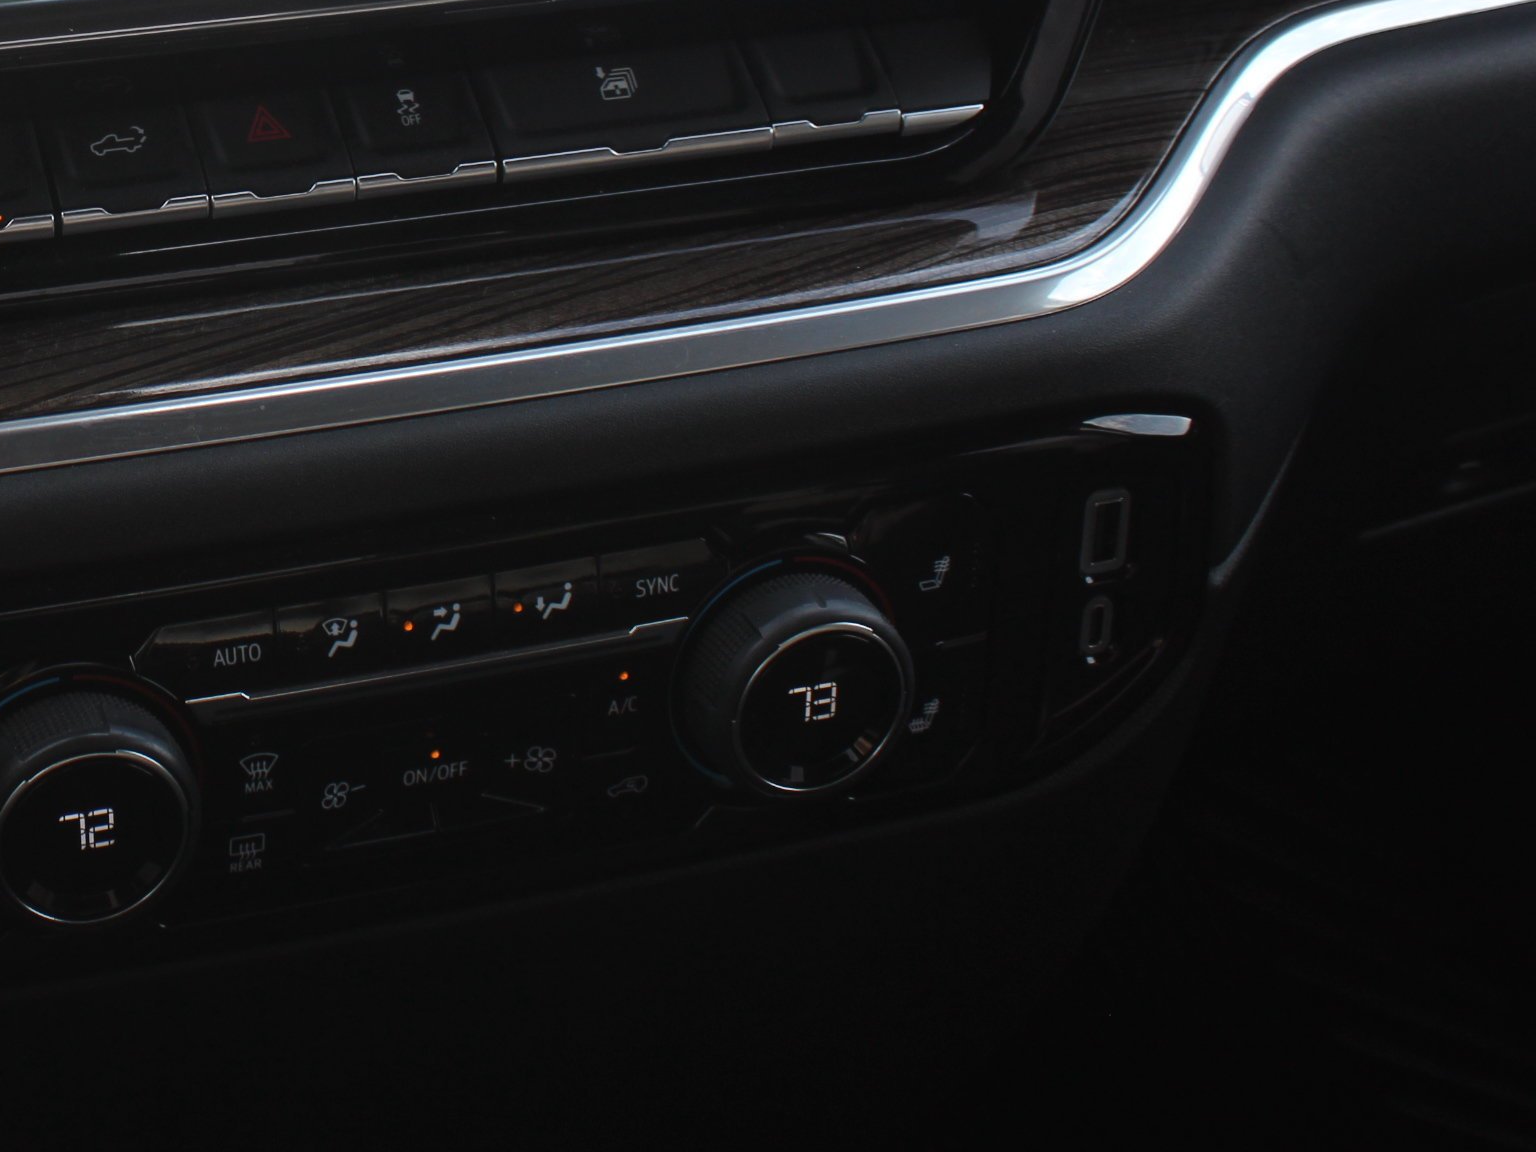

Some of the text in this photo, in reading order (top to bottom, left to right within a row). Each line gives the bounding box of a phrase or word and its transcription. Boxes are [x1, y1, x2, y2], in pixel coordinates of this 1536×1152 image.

[401, 113, 421, 127] OFF
[635, 573, 680, 600] SYNC
[213, 642, 262, 668] AUTO
[607, 696, 638, 717] A/C
[787, 681, 838, 723] 73
[402, 760, 468, 786] ON/OFF
[244, 779, 274, 794] MAX
[58, 806, 116, 851] 72
[229, 857, 263, 874] REAR
